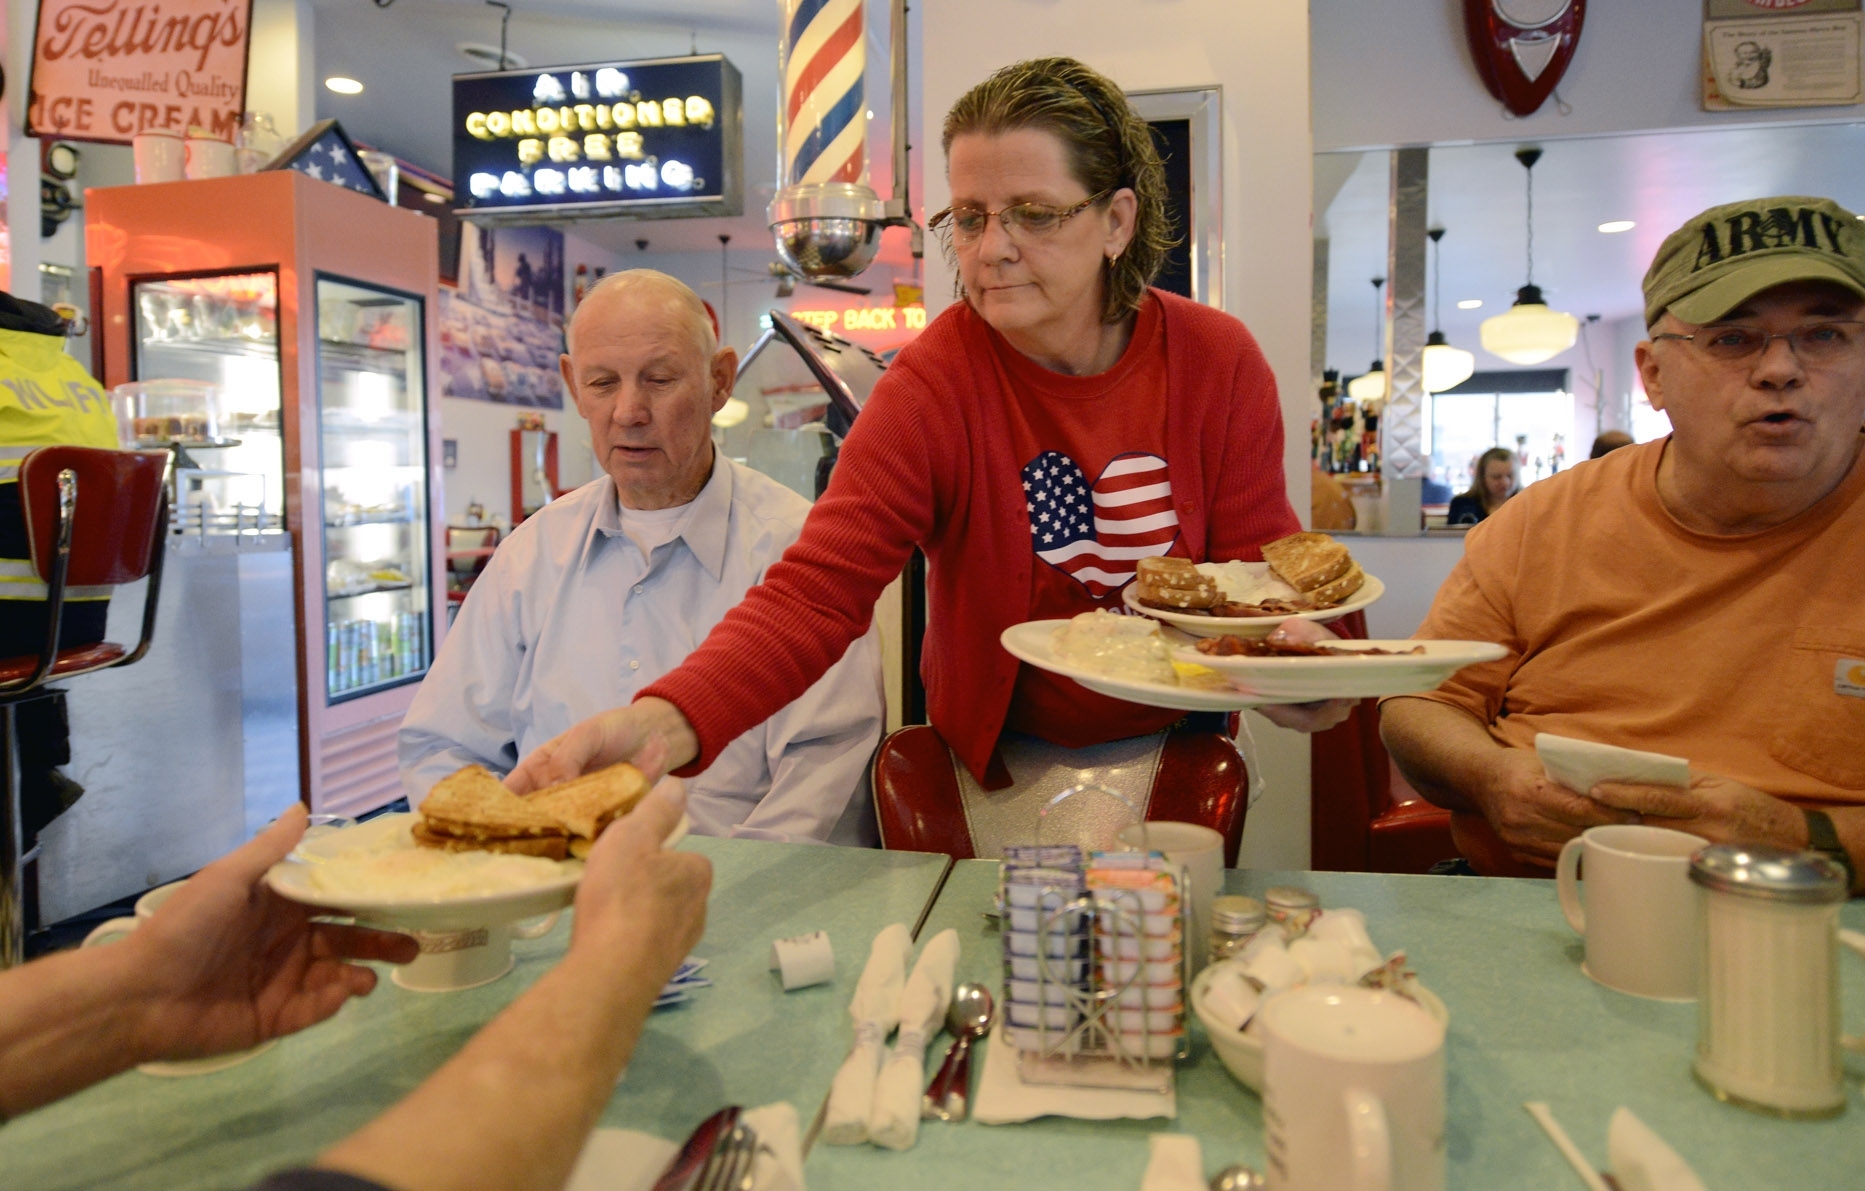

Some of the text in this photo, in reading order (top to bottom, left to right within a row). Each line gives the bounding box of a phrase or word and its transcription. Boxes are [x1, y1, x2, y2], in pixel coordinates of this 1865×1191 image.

[43, 0, 243, 72] Tellings
[88, 69, 239, 102] Unequalled Quality
[533, 67, 630, 99] AIR
[35, 95, 94, 131] ICE
[466, 95, 715, 141] CONDITIONED
[518, 131, 646, 164] FREE
[469, 159, 695, 198] PARKING
[1691, 206, 1848, 274] ARMY
[843, 307, 897, 330] BACK
[902, 307, 927, 329] TO
